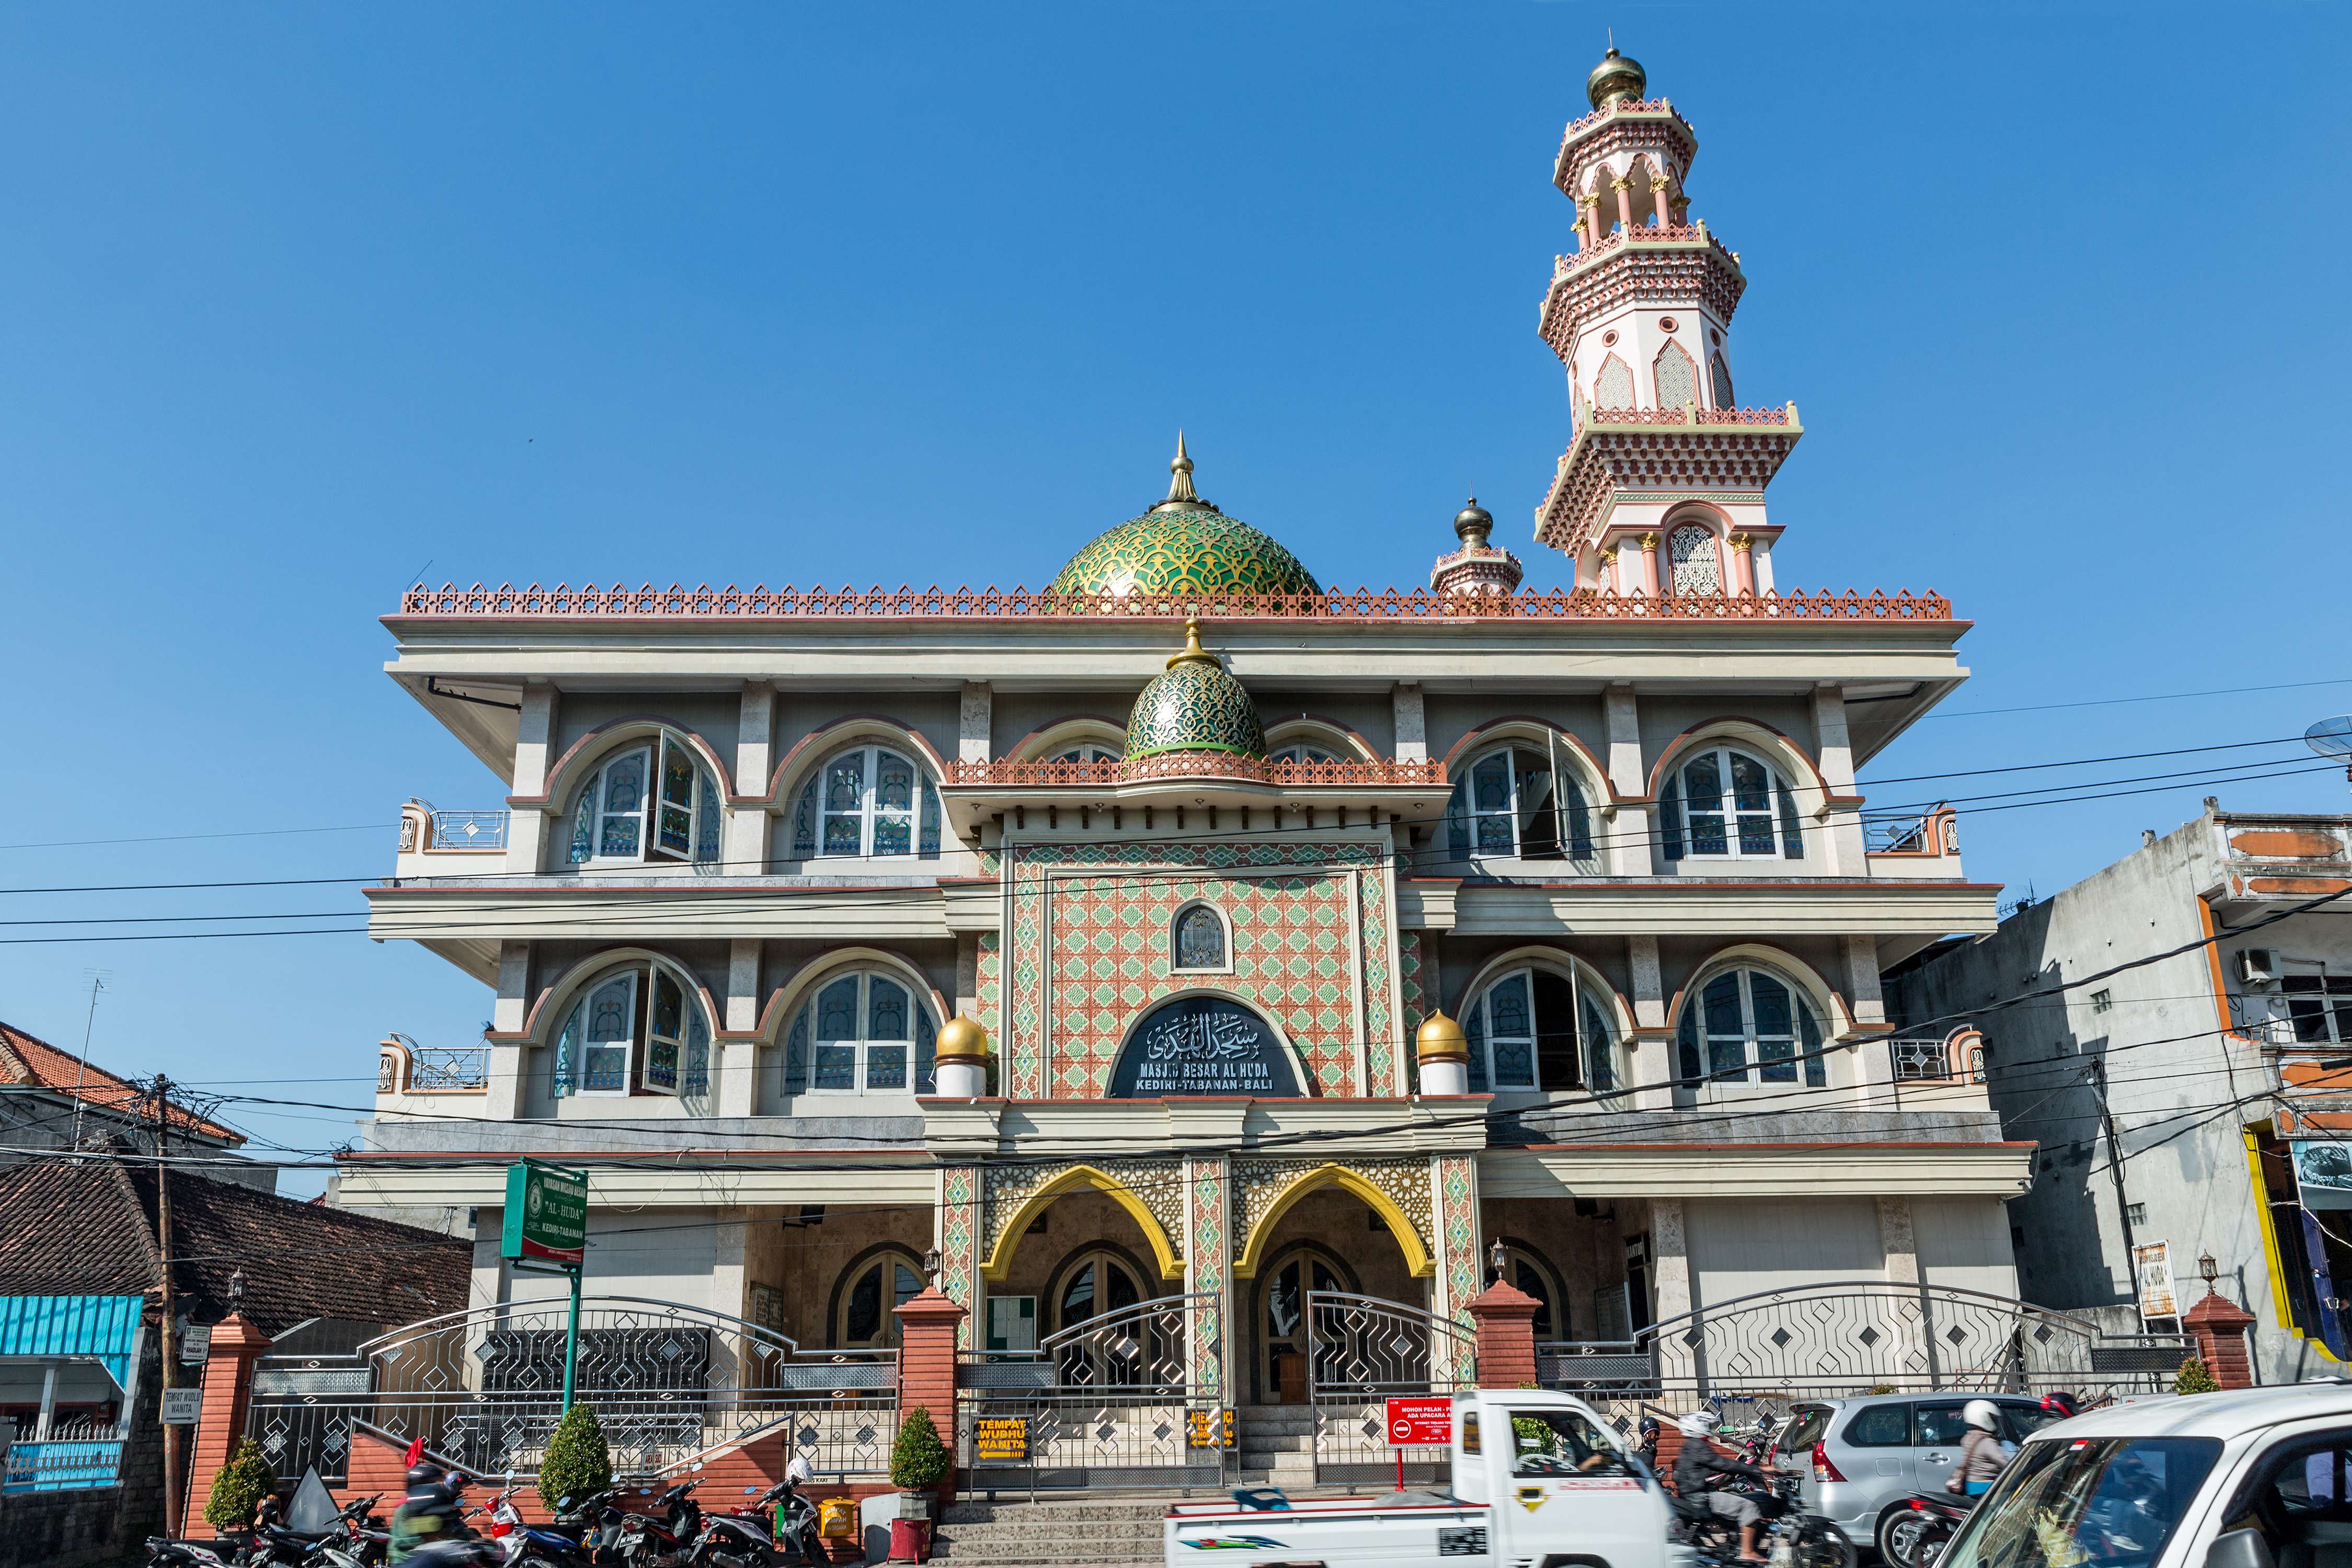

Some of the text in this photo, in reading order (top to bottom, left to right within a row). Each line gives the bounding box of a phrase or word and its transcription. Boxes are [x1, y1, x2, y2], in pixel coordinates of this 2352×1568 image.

[1140, 1063, 1269, 1078] MASJID BESAR AL HUDA
[166, 1392, 183, 1402] TEMPAT
[171, 1403, 192, 1413] WANITA
[978, 1420, 1026, 1429] TEMPAT
[979, 1429, 1025, 1438] WUDHU
[978, 1440, 1025, 1449] WANITA
